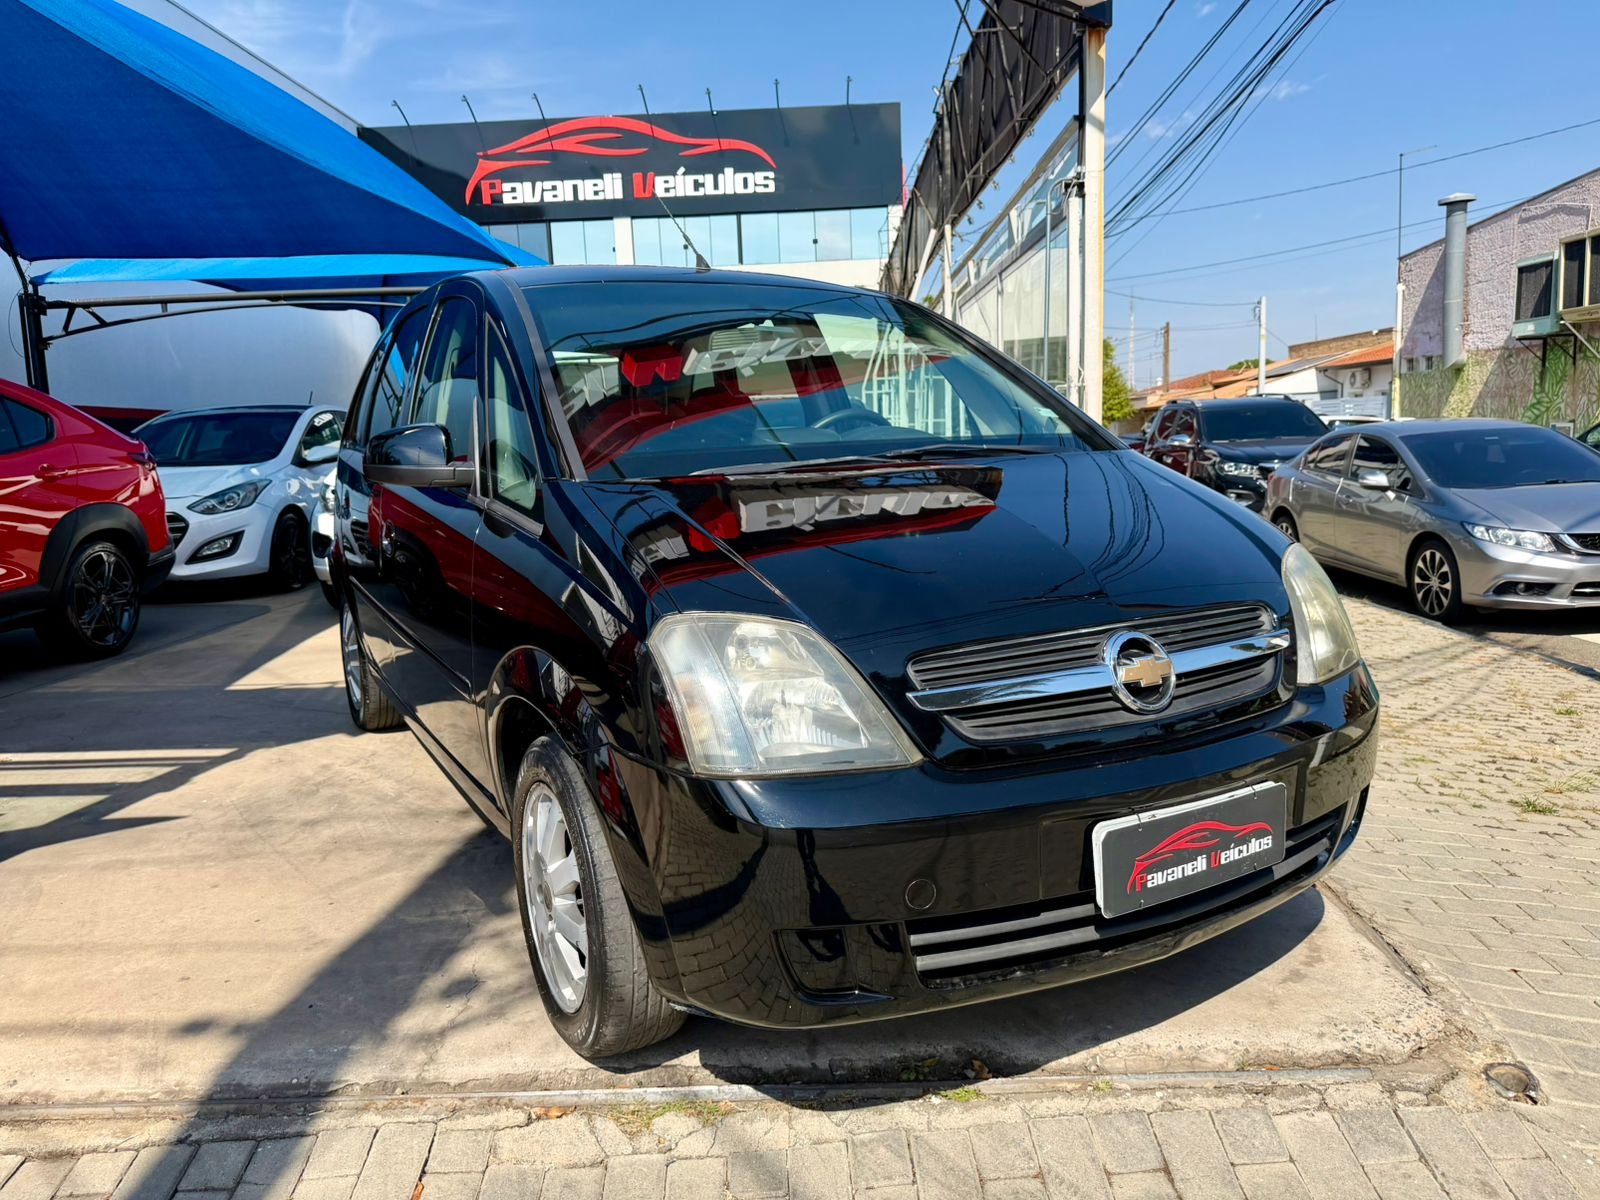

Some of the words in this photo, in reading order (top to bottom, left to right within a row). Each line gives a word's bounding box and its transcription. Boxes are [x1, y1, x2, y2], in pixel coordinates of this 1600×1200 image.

[482, 172, 623, 204] Pavaneli
[633, 167, 775, 198] Veículos
[1135, 855, 1208, 892] Pavaneli
[1211, 835, 1273, 868] Veículos
